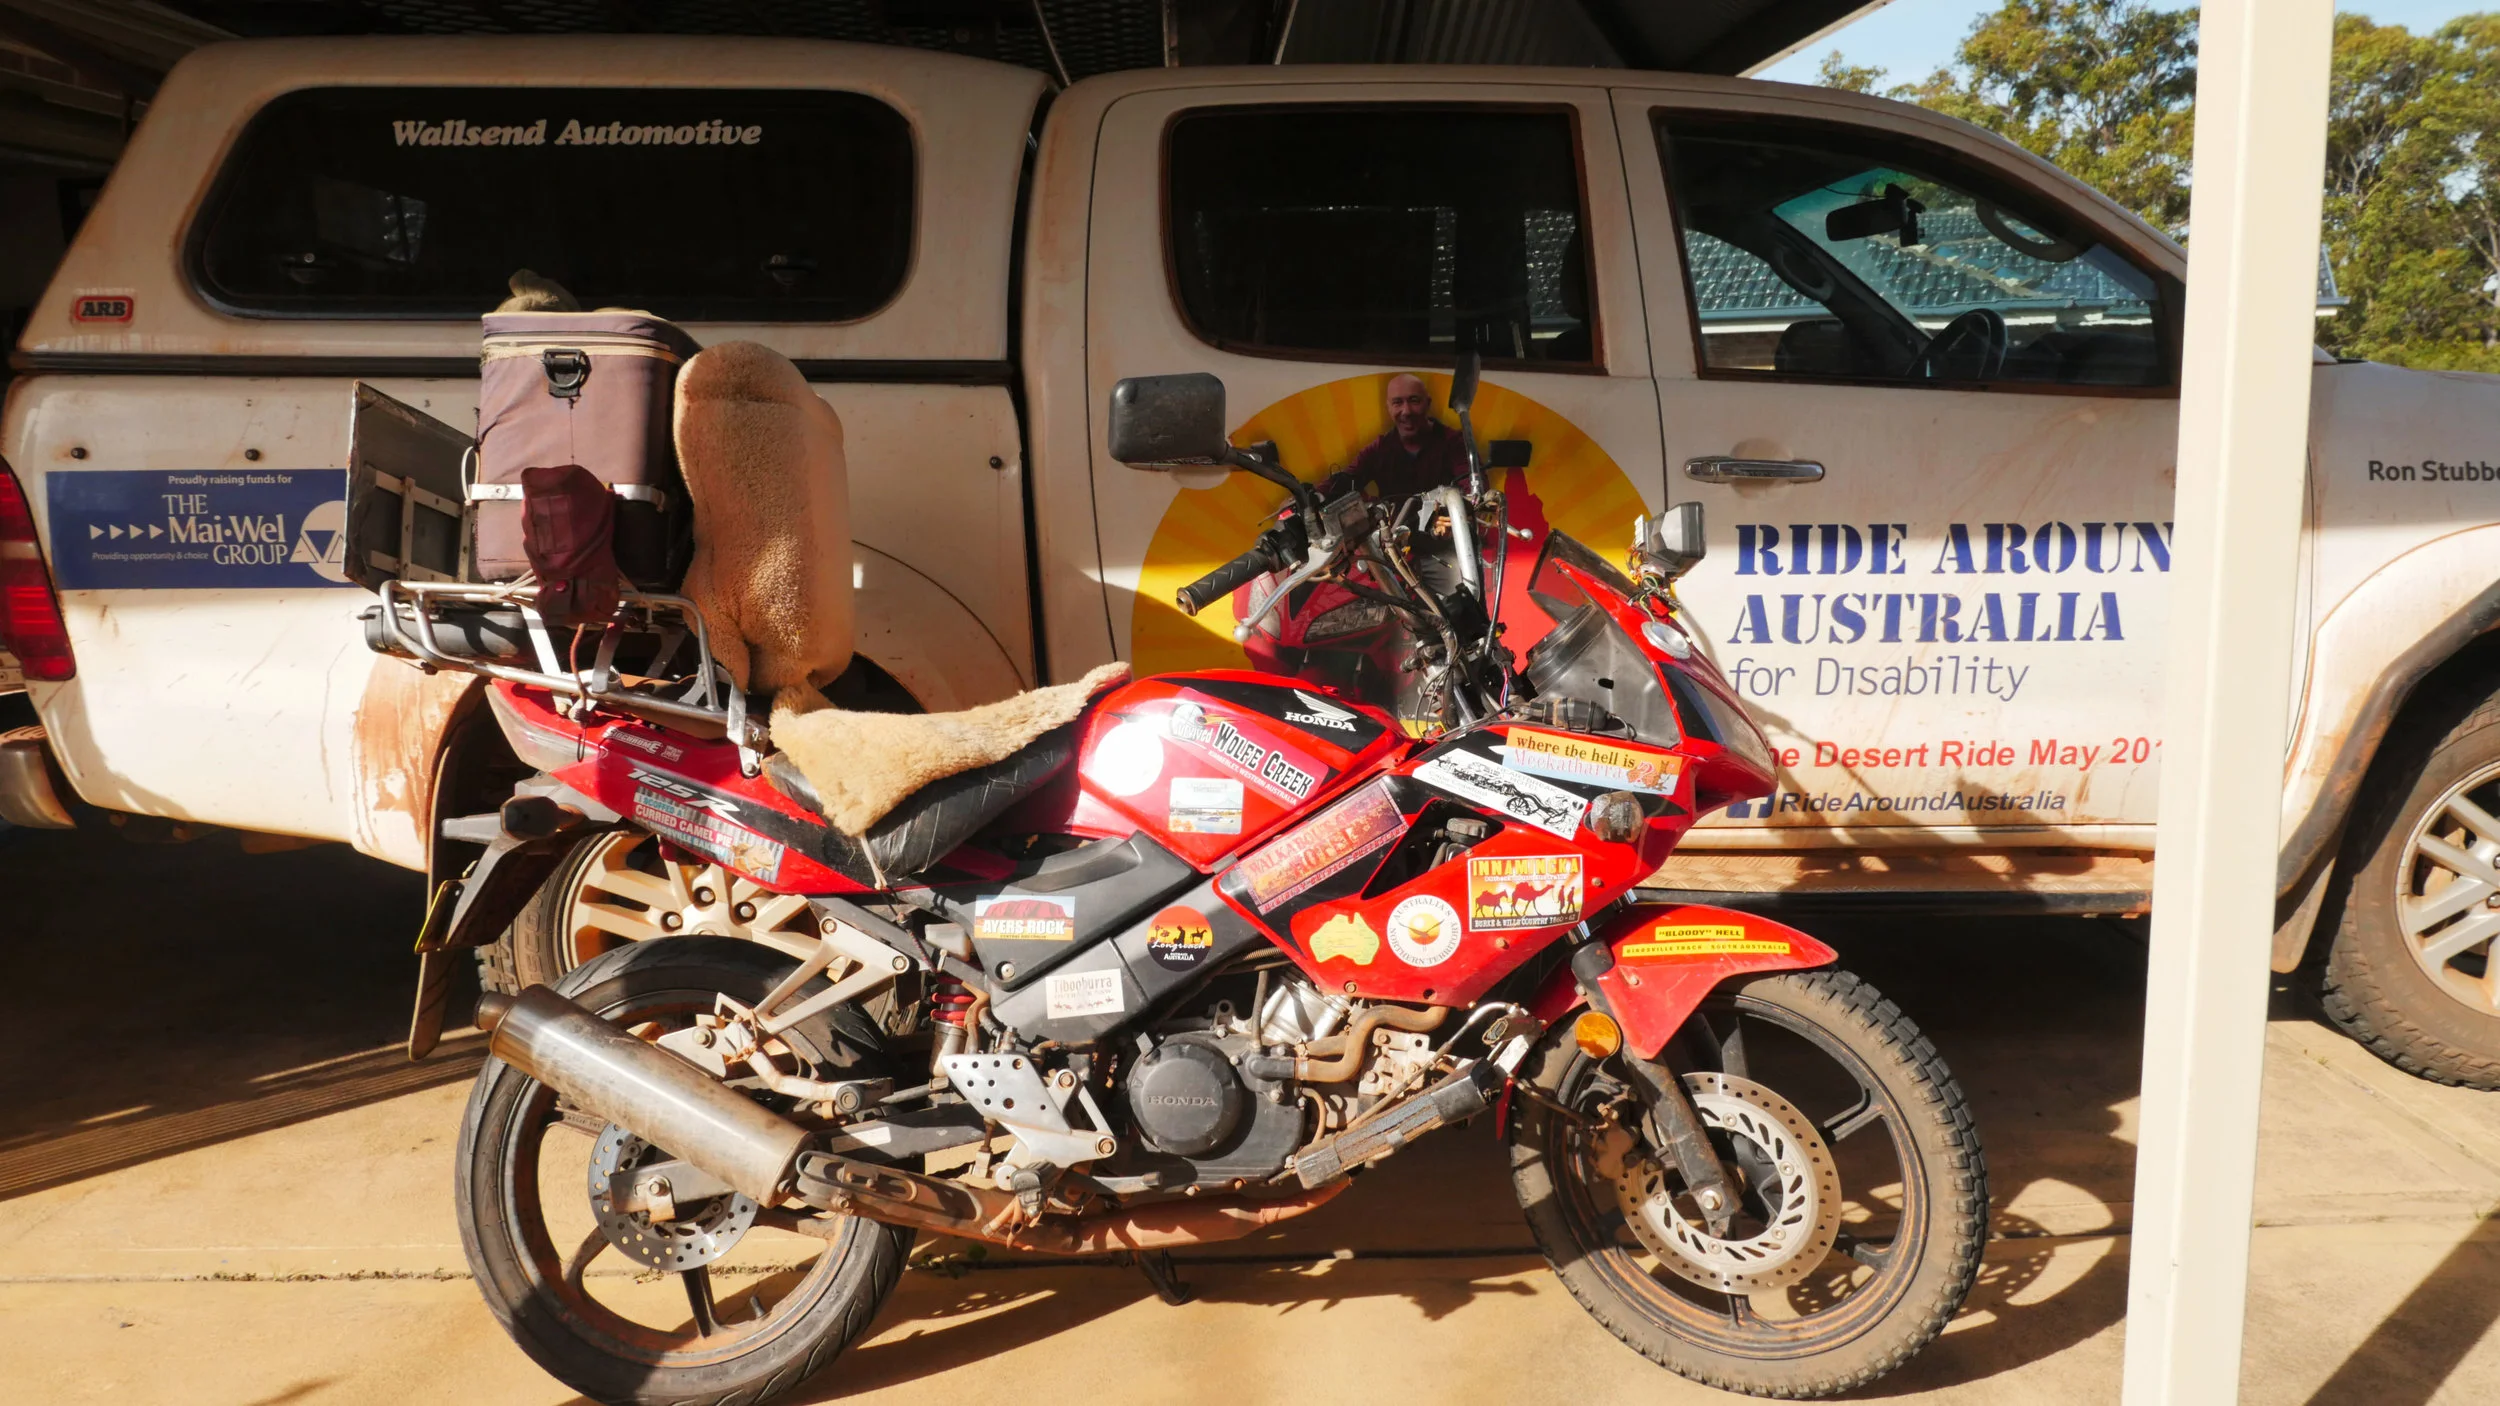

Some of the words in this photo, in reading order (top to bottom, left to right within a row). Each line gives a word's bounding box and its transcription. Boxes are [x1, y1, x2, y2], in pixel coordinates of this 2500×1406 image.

[392, 119, 547, 146] Wallsend
[554, 119, 762, 146] Automotive
[82, 301, 127, 317] ARB
[168, 475, 208, 486] Proudly
[210, 475, 245, 486] raising
[247, 475, 275, 485] funds
[277, 475, 292, 484] for
[2368, 460, 2416, 481] Ron
[162, 494, 208, 515] THE
[92, 552, 129, 562] Providing
[129, 552, 176, 562] opportunity
[183, 552, 209, 560] choice
[213, 544, 288, 565] GROUP
[1734, 523, 1907, 576] RIDE
[1931, 521, 2174, 574] AROUN
[1727, 592, 2124, 644] AUSTRALIA
[1729, 657, 1795, 696] for
[1815, 655, 2030, 702] Disability
[1284, 711, 1357, 732] HONDA
[1212, 721, 1265, 770] WOLFE
[1261, 750, 1315, 799] CREEK
[1516, 736, 1560, 756] where
[1564, 744, 1587, 760] the
[1591, 749, 1619, 766] hell
[1623, 754, 1636, 769] is
[1814, 741, 1929, 768] Desert
[1939, 740, 2016, 767] Ride
[2028, 739, 2101, 772] May
[2109, 737, 2162, 764] 20
[1513, 750, 1623, 779] Meekatharra
[643, 795, 675, 813] SCOFFED
[1265, 783, 1298, 806] AUSTRALIA
[1779, 791, 2067, 812] RideAroundAustralia
[635, 804, 678, 828] CURRIED
[679, 817, 714, 843] CAMEL
[715, 833, 734, 848] PIE
[1473, 857, 1579, 876] INNAMINCKA
[1394, 897, 1452, 919] AUSTRALIA'S
[982, 919, 1024, 934] AYERS
[1027, 920, 1066, 935] ROCK
[1715, 929, 1741, 937] HELL
[1740, 943, 1787, 951] AUSTRALIA
[1148, 1095, 1218, 1107] HONDA
